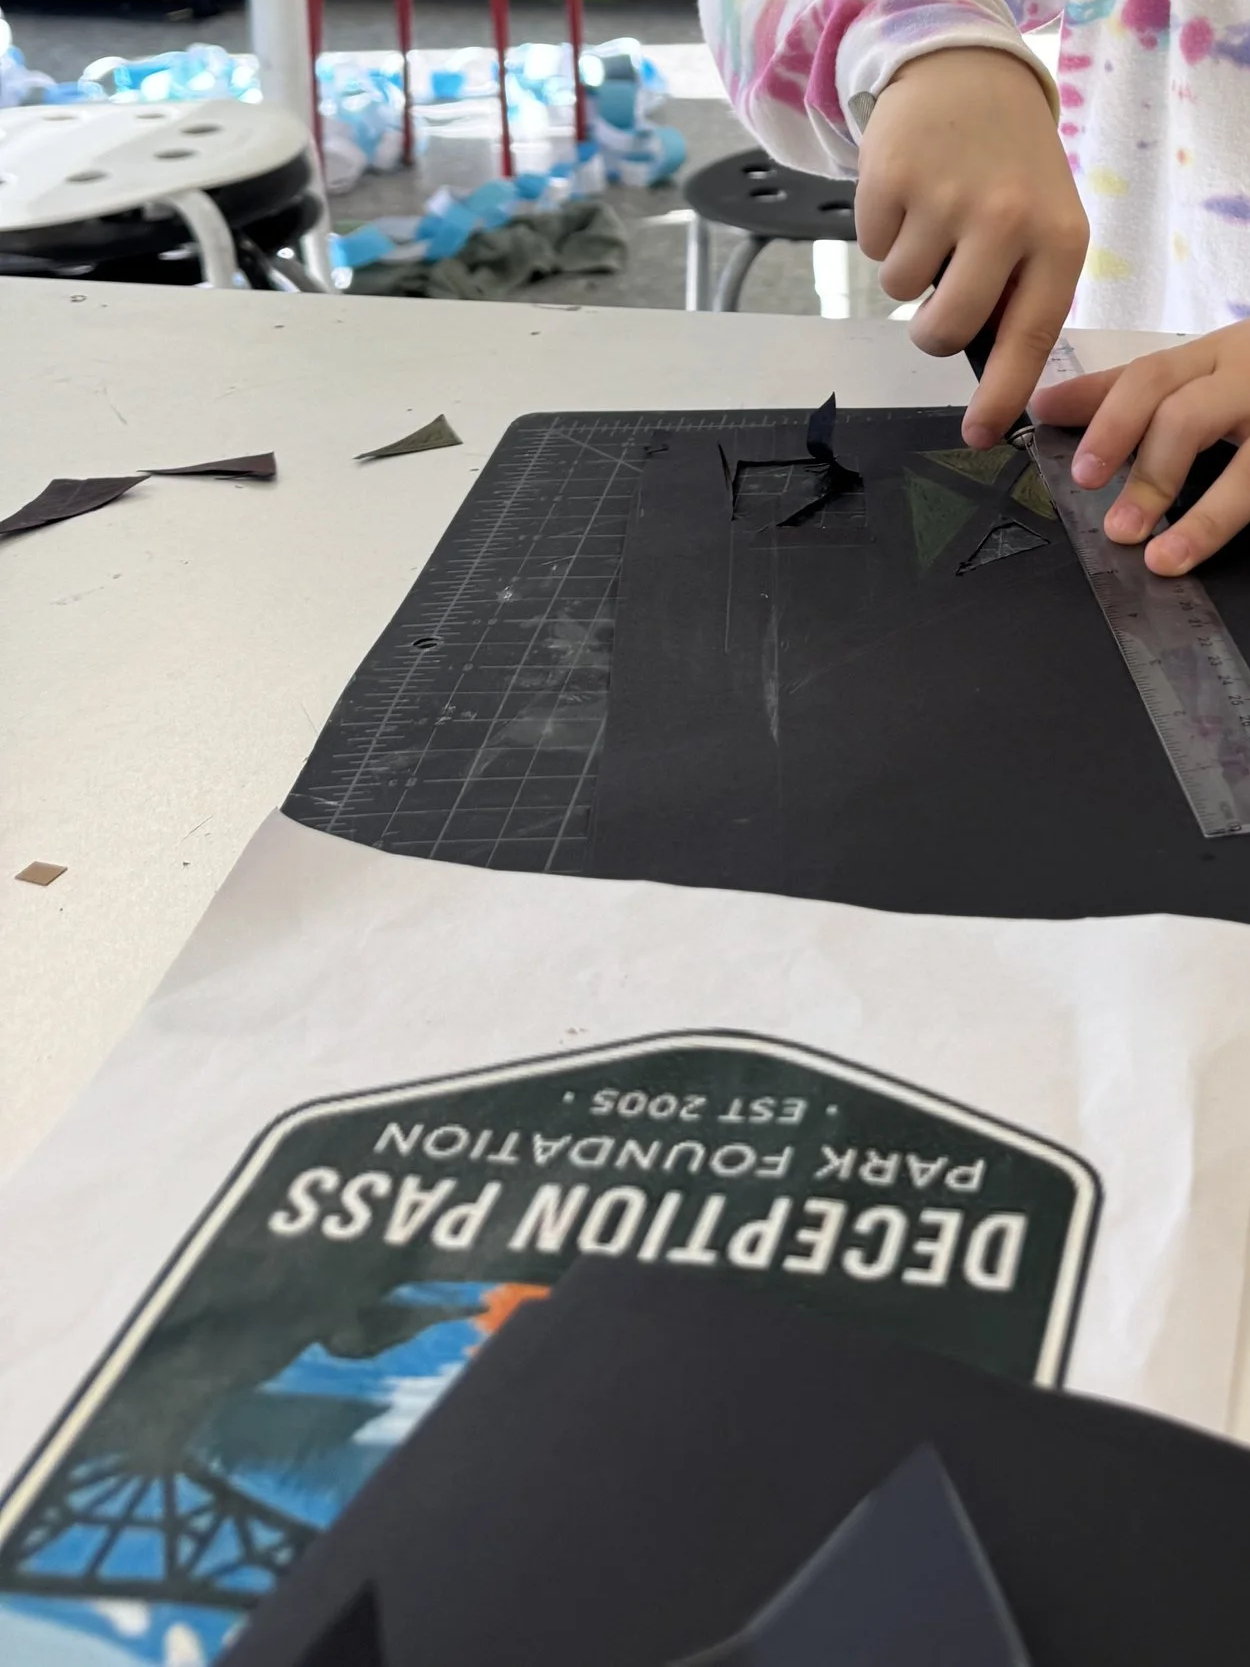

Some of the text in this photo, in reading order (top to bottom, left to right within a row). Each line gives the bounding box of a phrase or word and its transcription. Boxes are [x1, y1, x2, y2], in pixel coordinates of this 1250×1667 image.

[1228, 695, 1244, 706] 25
[589, 1088, 808, 1124] EST 2005
[373, 1121, 987, 1192] PARK FOUNDATION
[267, 1166, 1028, 1292] DECEPTION PASS
